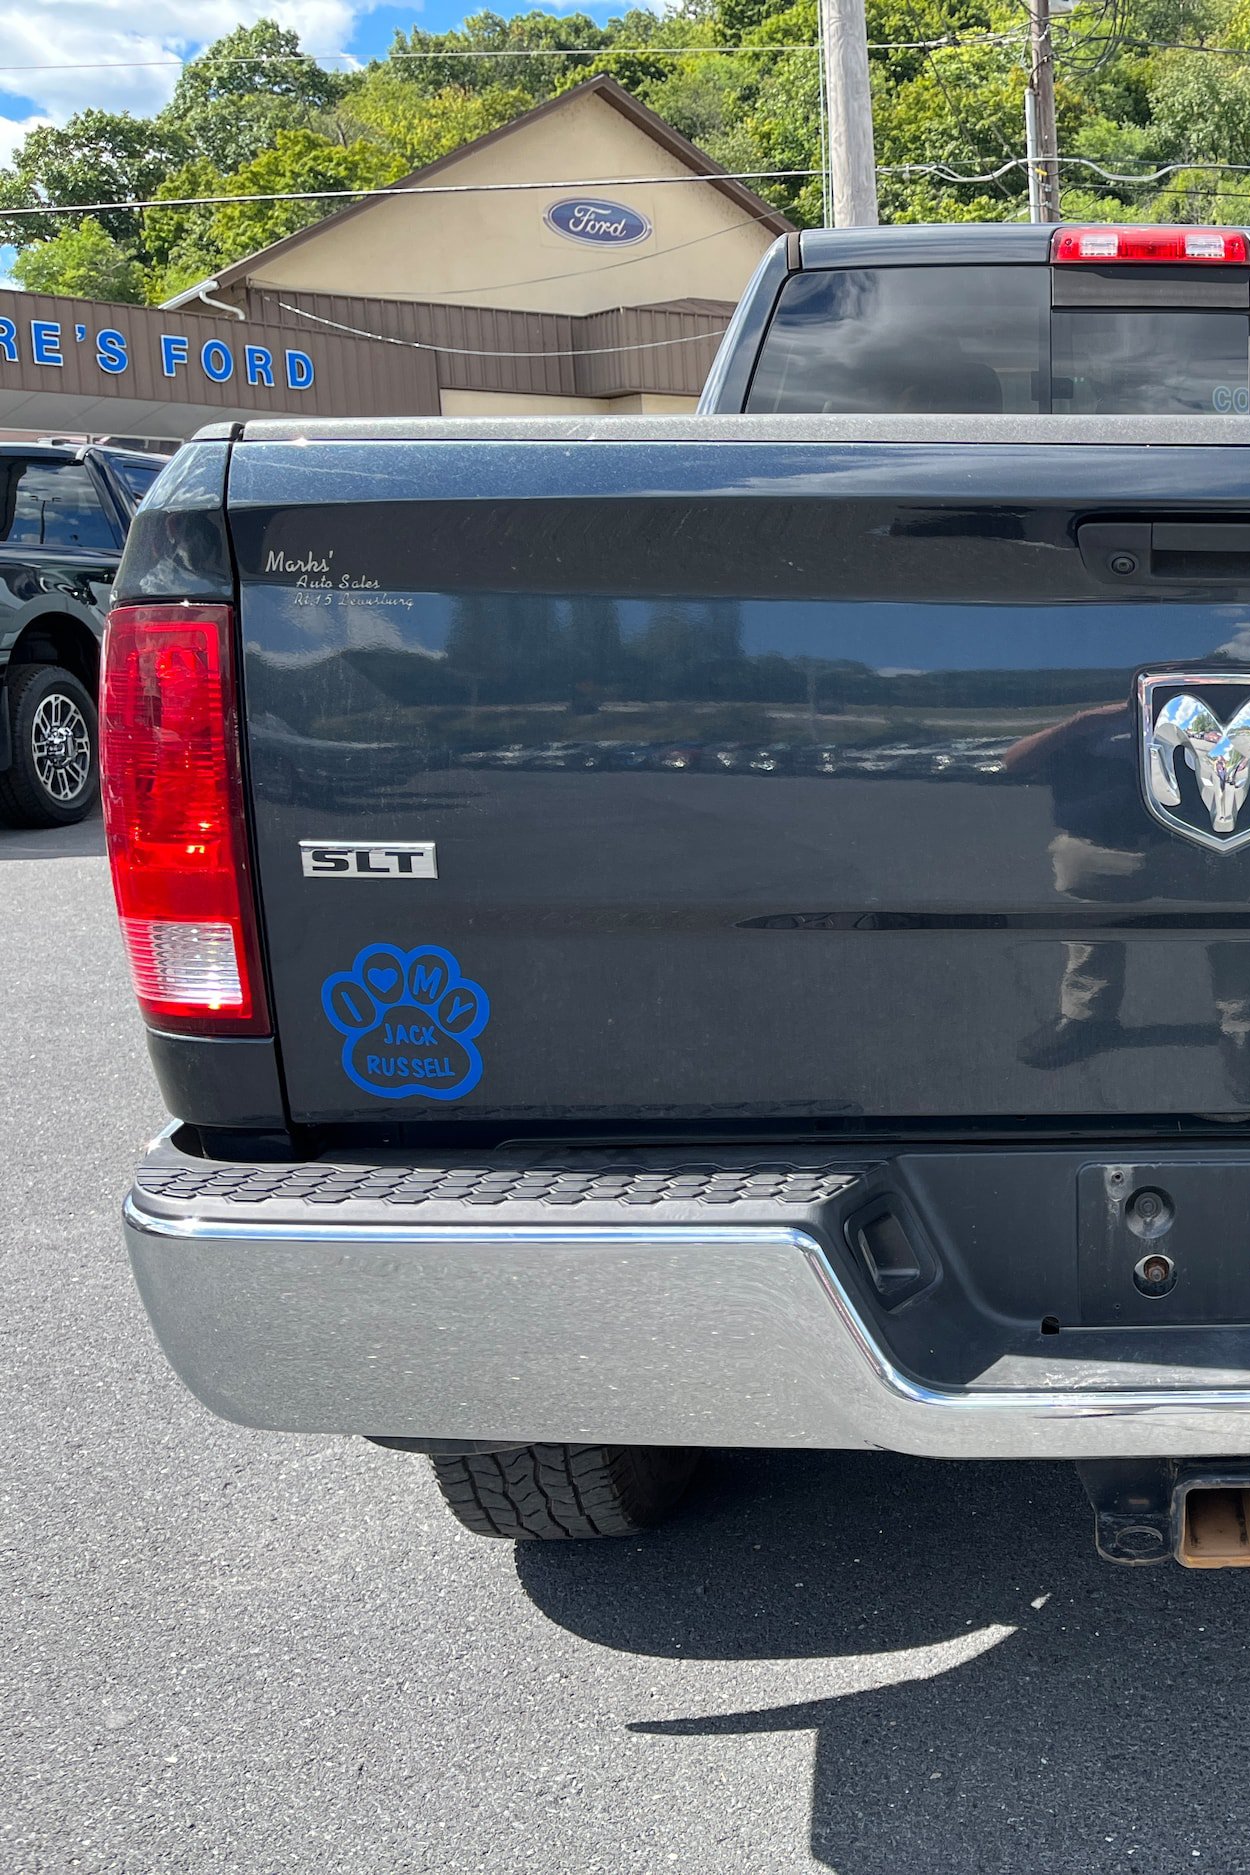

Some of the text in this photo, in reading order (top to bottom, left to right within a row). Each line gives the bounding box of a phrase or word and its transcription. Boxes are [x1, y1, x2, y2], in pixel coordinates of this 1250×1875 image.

[569, 205, 627, 237] Ford
[160, 334, 315, 391] FORD
[265, 550, 334, 573] Marks'
[296, 574, 381, 589] Auto Sales
[311, 850, 424, 873] SLT
[341, 991, 363, 1022] I
[384, 1023, 437, 1046] JACK
[366, 1055, 456, 1079] RUSSELL
